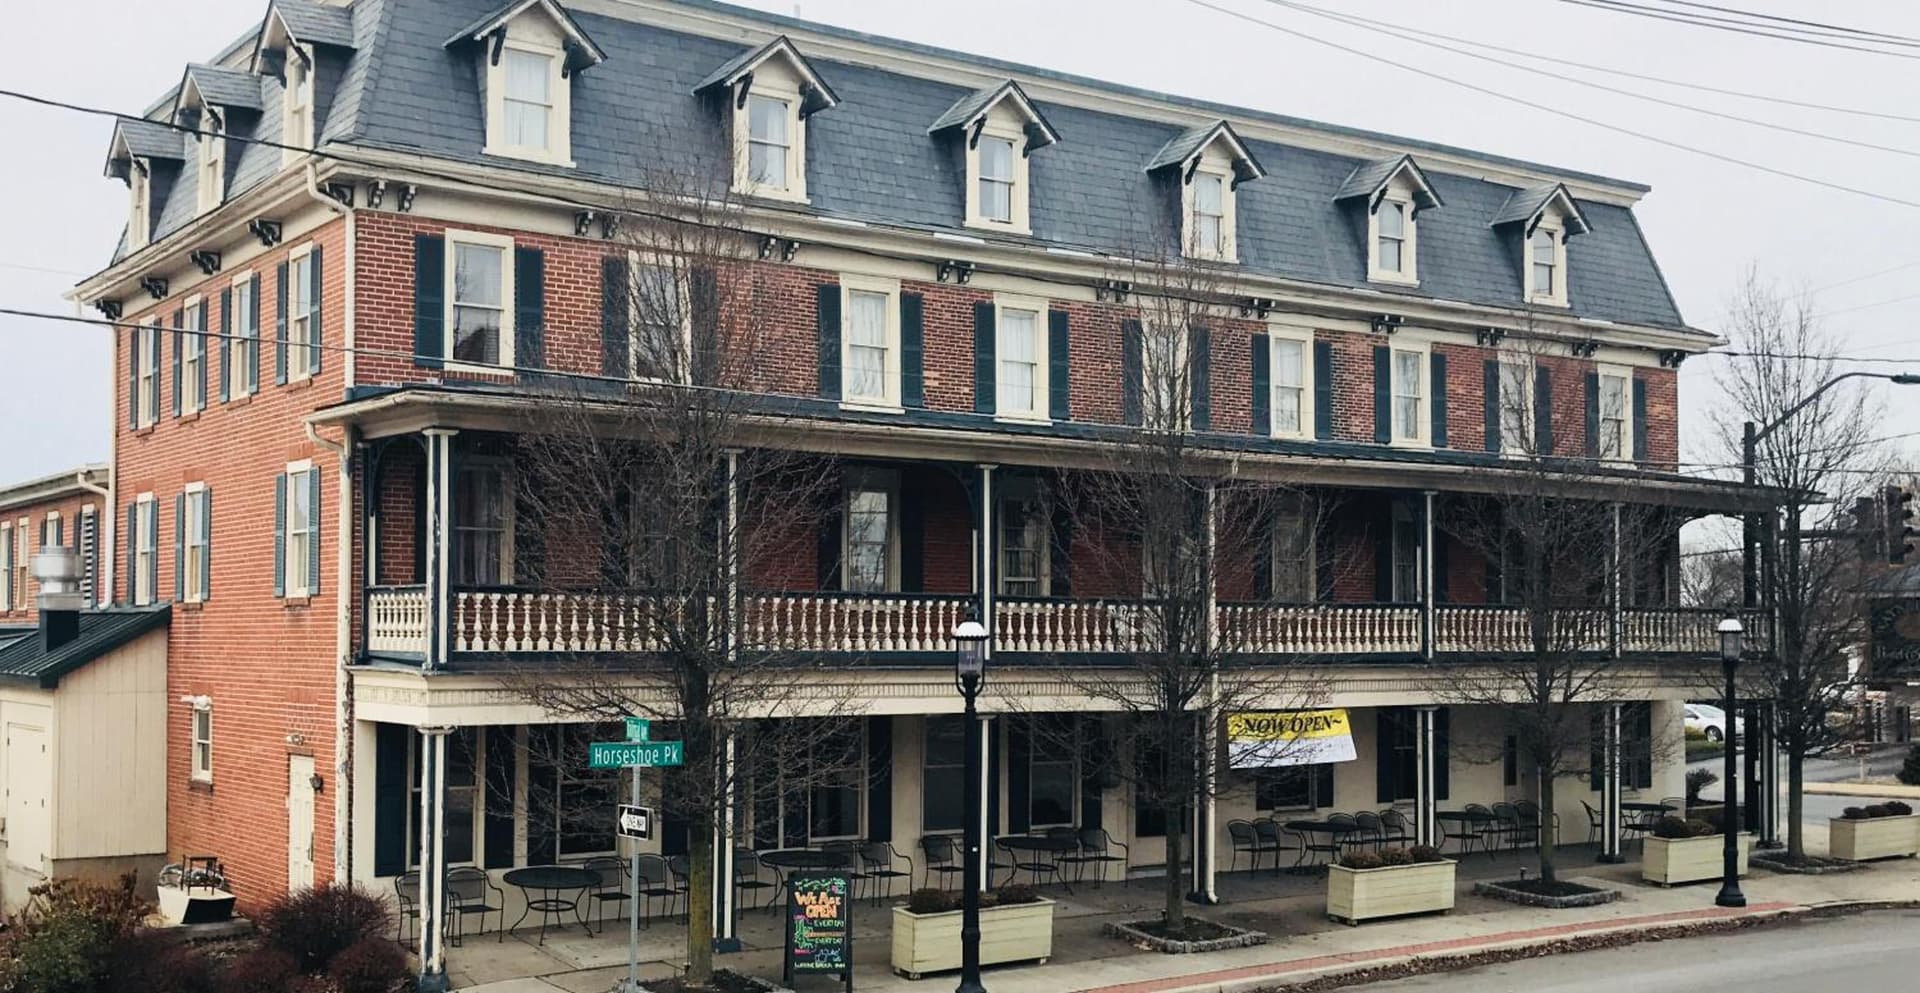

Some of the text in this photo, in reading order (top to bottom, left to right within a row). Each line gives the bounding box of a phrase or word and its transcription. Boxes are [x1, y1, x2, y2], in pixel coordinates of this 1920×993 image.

[594, 744, 678, 765] Horseshoe Pk
[806, 904, 837, 918] OPEN
